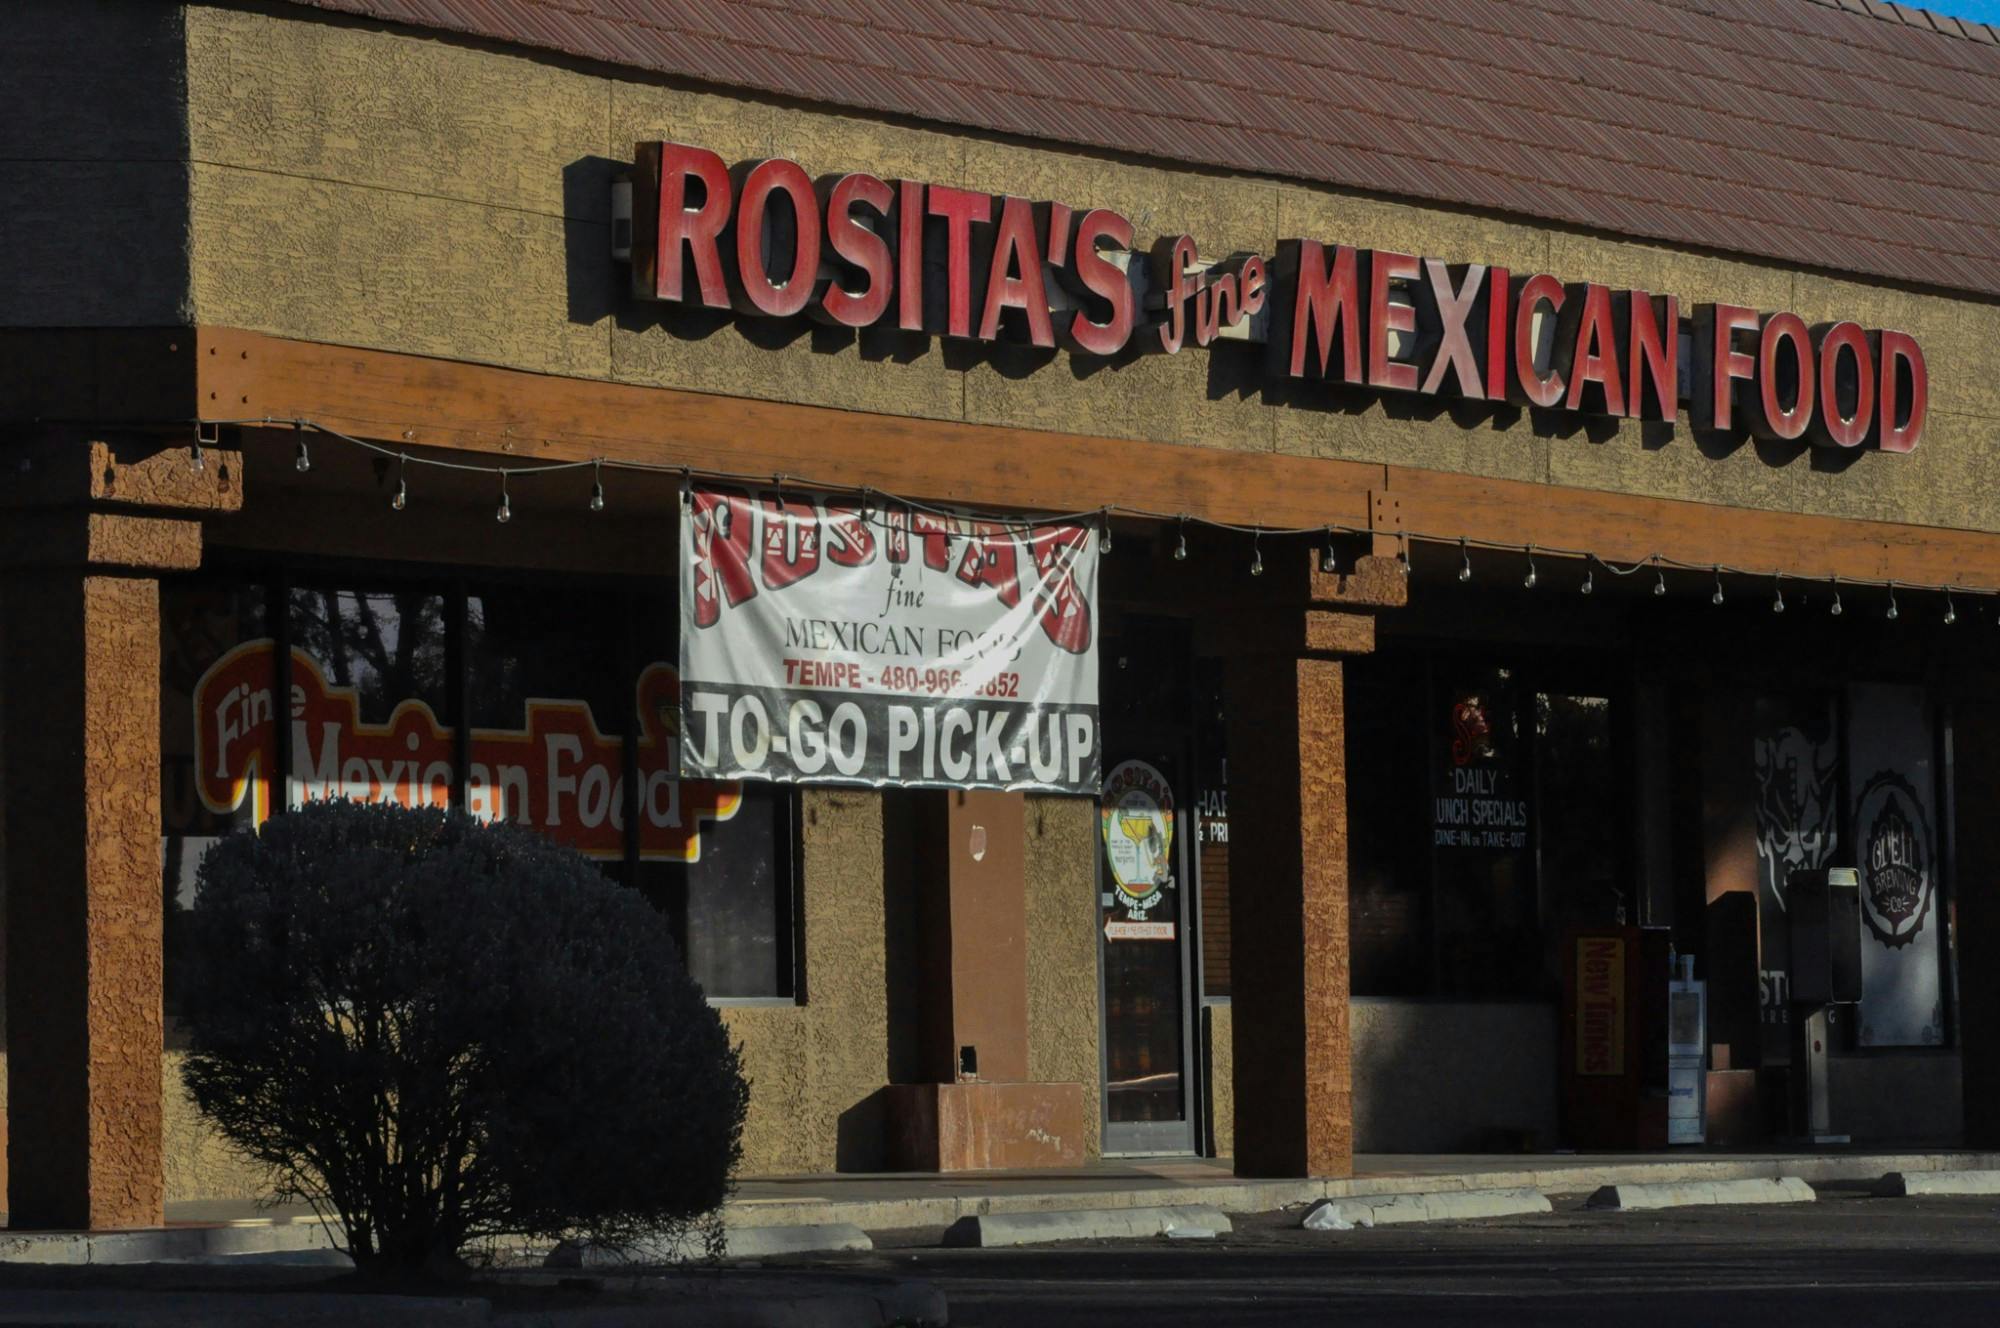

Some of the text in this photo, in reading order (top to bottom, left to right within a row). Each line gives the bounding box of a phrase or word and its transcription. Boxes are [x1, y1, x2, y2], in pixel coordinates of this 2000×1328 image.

[656, 140, 1928, 454] ROSITA'S fine MEXICAN FOOD
[879, 572, 926, 618] fine
[784, 616, 926, 658] MEXICAN
[782, 658, 862, 690] TEMPE
[215, 681, 307, 779] Fine
[691, 691, 1094, 784] TO-GO PICK-UP
[543, 732, 683, 832] Food
[1455, 767, 1498, 795] DAILY
[1471, 798, 1527, 827] SPECIALS
[1434, 829, 1471, 848] DINE-IN
[1480, 831, 1527, 848] TAKE-OUT
[1873, 868, 1918, 897] BREWING
[1585, 941, 1618, 994] New
